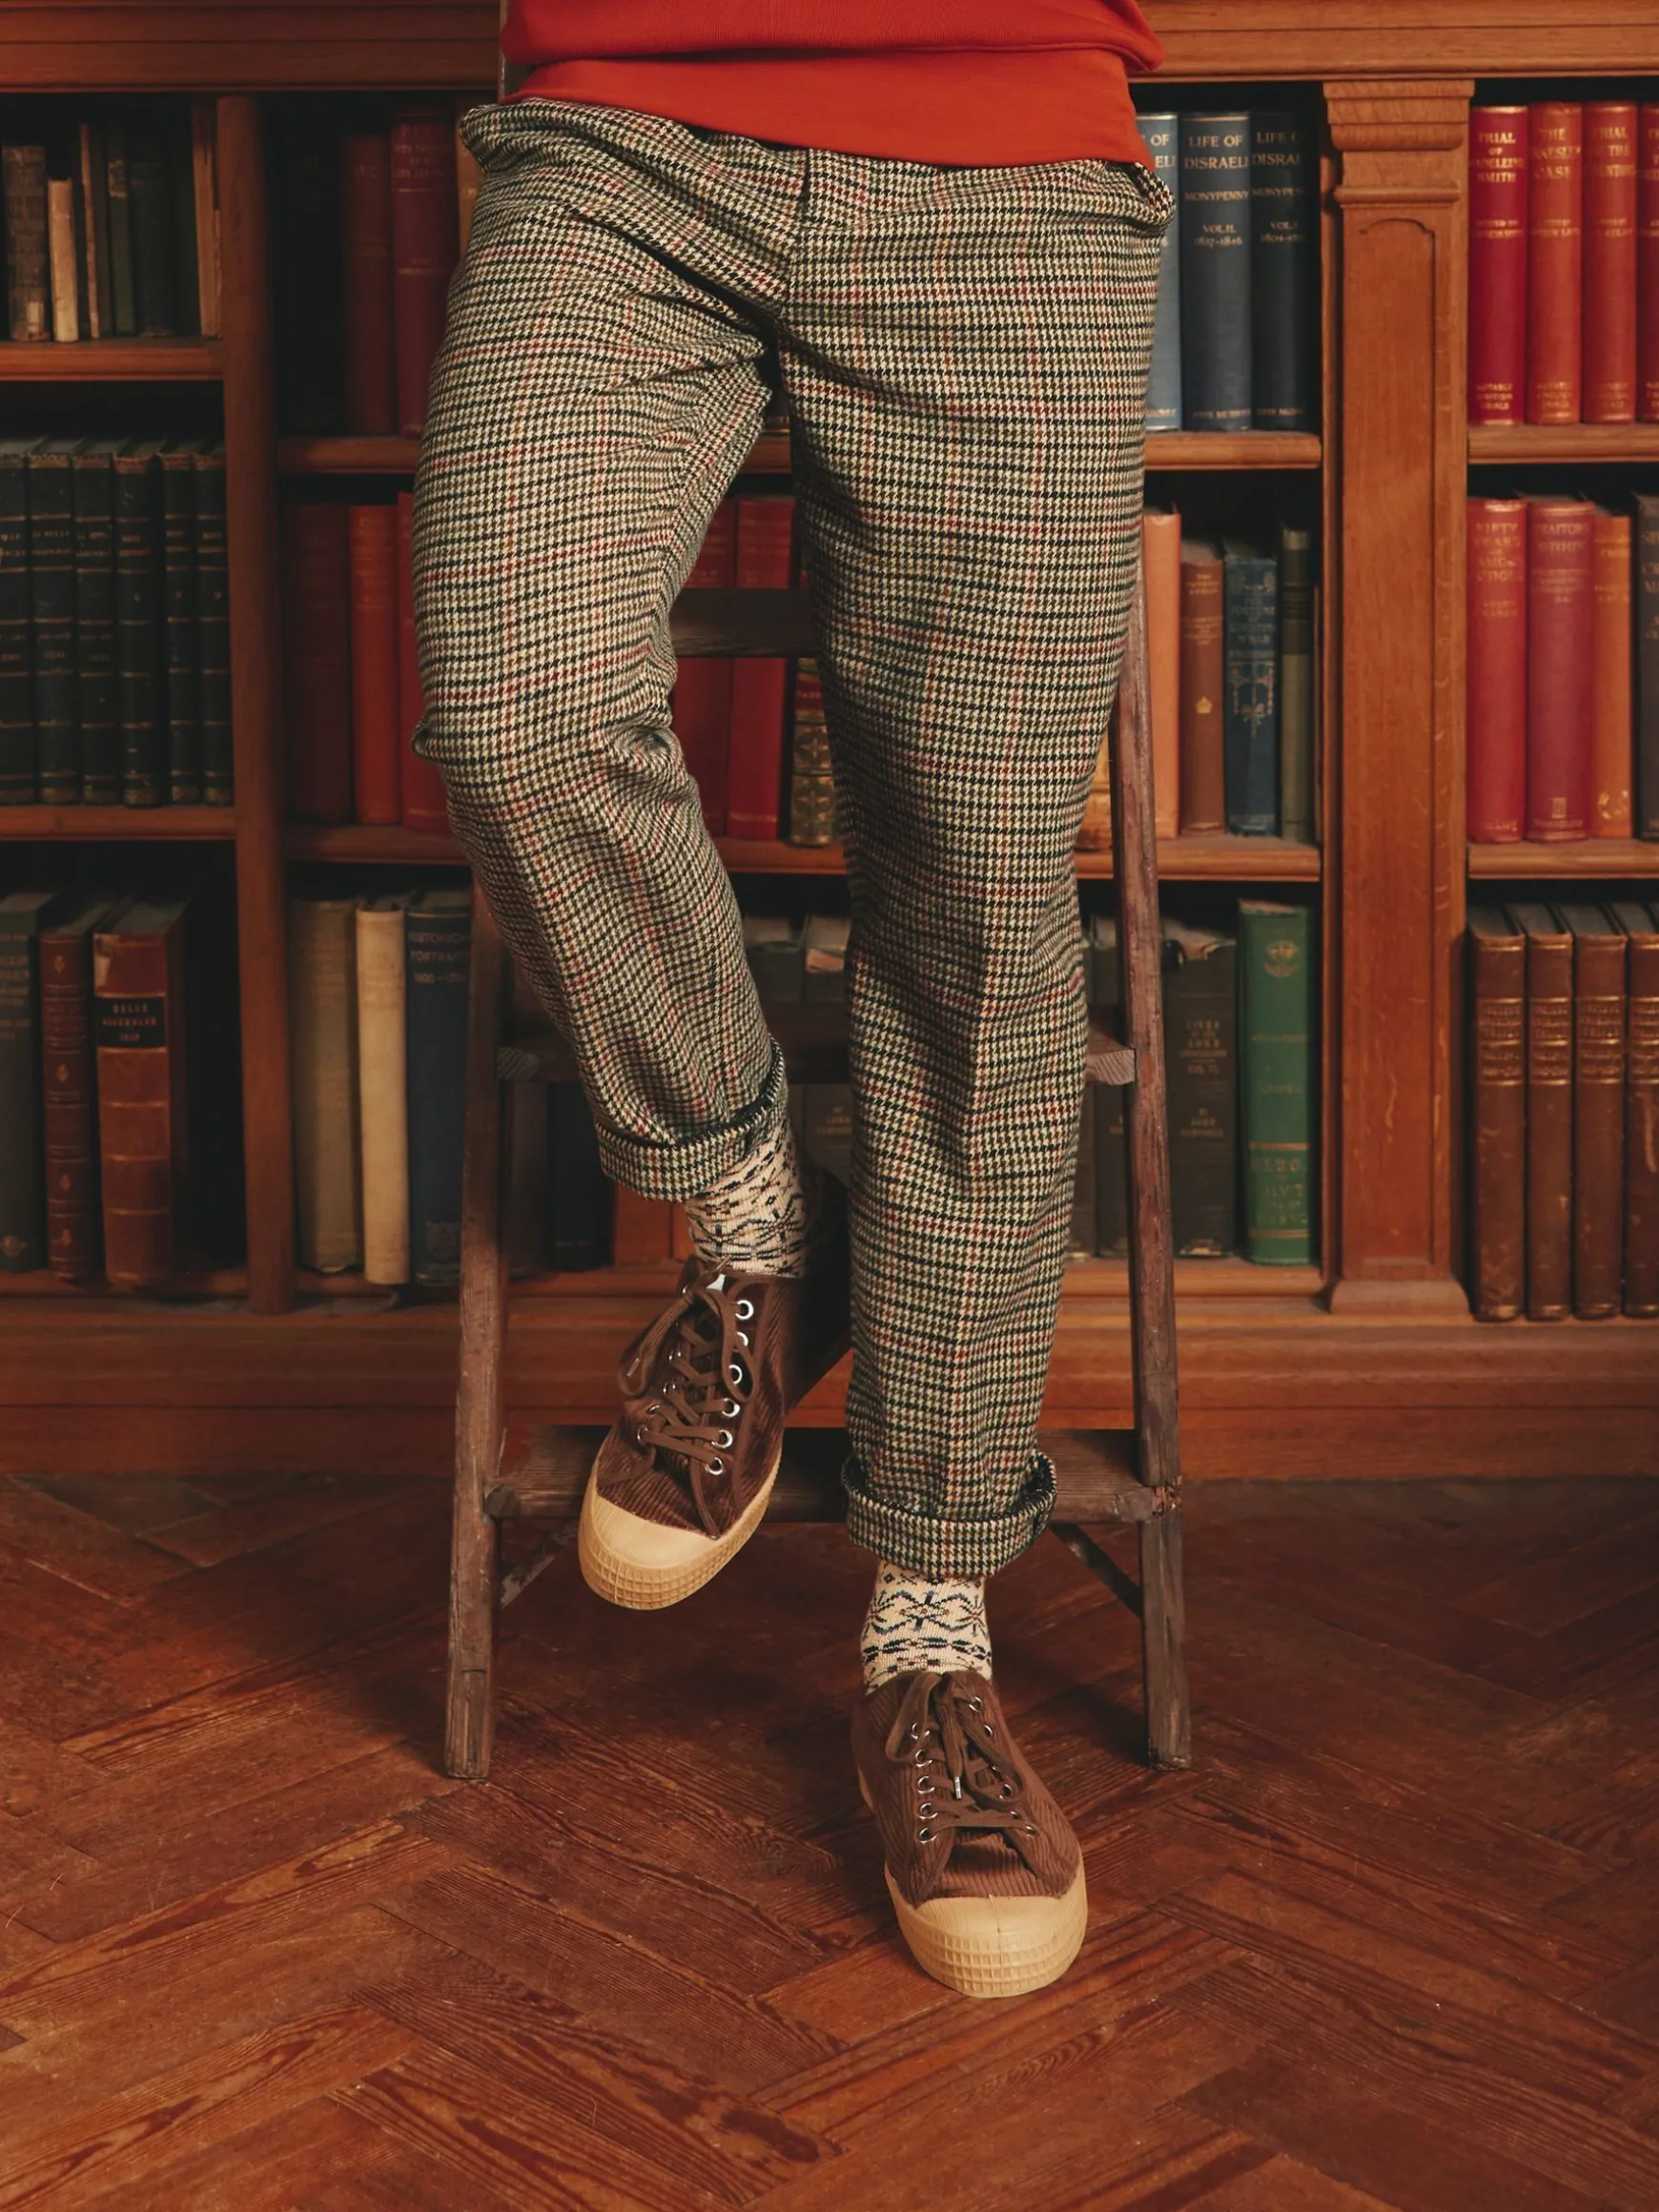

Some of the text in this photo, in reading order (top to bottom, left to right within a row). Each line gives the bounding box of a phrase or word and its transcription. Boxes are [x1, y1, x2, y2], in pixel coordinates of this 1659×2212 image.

[1150, 133, 1171, 147] OF
[1189, 133, 1244, 148] LIFE OF
[1257, 131, 1286, 144] LIFE
[1479, 132, 1516, 144] TRIAL
[1488, 147, 1504, 155] OF
[1184, 155, 1249, 170] DISRAELI
[1252, 153, 1301, 166] DISRA
[1477, 172, 1516, 183] SMITH
[1184, 190, 1249, 201] MONYPENNY
